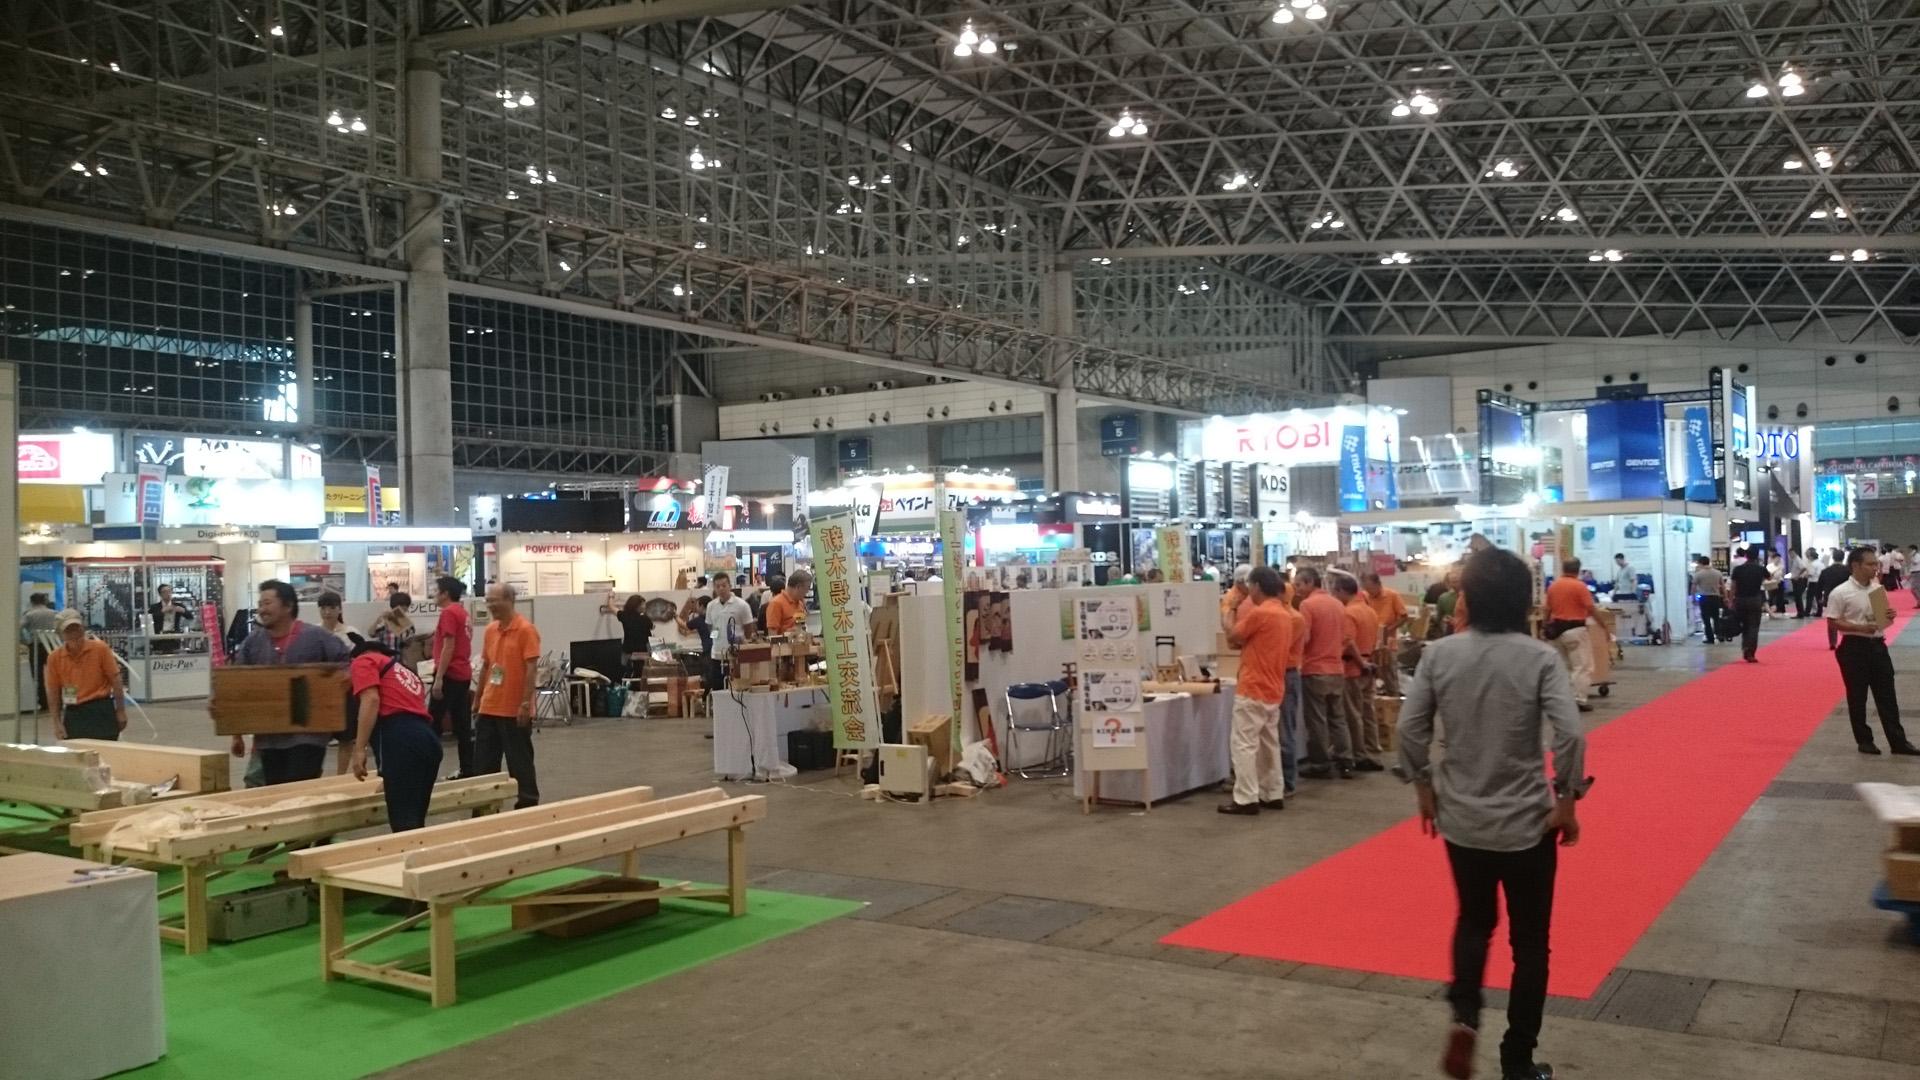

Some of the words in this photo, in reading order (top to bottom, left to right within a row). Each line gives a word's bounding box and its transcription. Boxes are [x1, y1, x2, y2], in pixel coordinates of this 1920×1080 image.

[1115, 427, 1123, 437] 5
[1236, 421, 1330, 452] RYOBI
[850, 449, 857, 458] 5
[1259, 473, 1288, 492] KDS
[895, 496, 933, 511] ペイント
[525, 545, 583, 553] POWERTECH
[628, 542, 680, 551] POWERTECH
